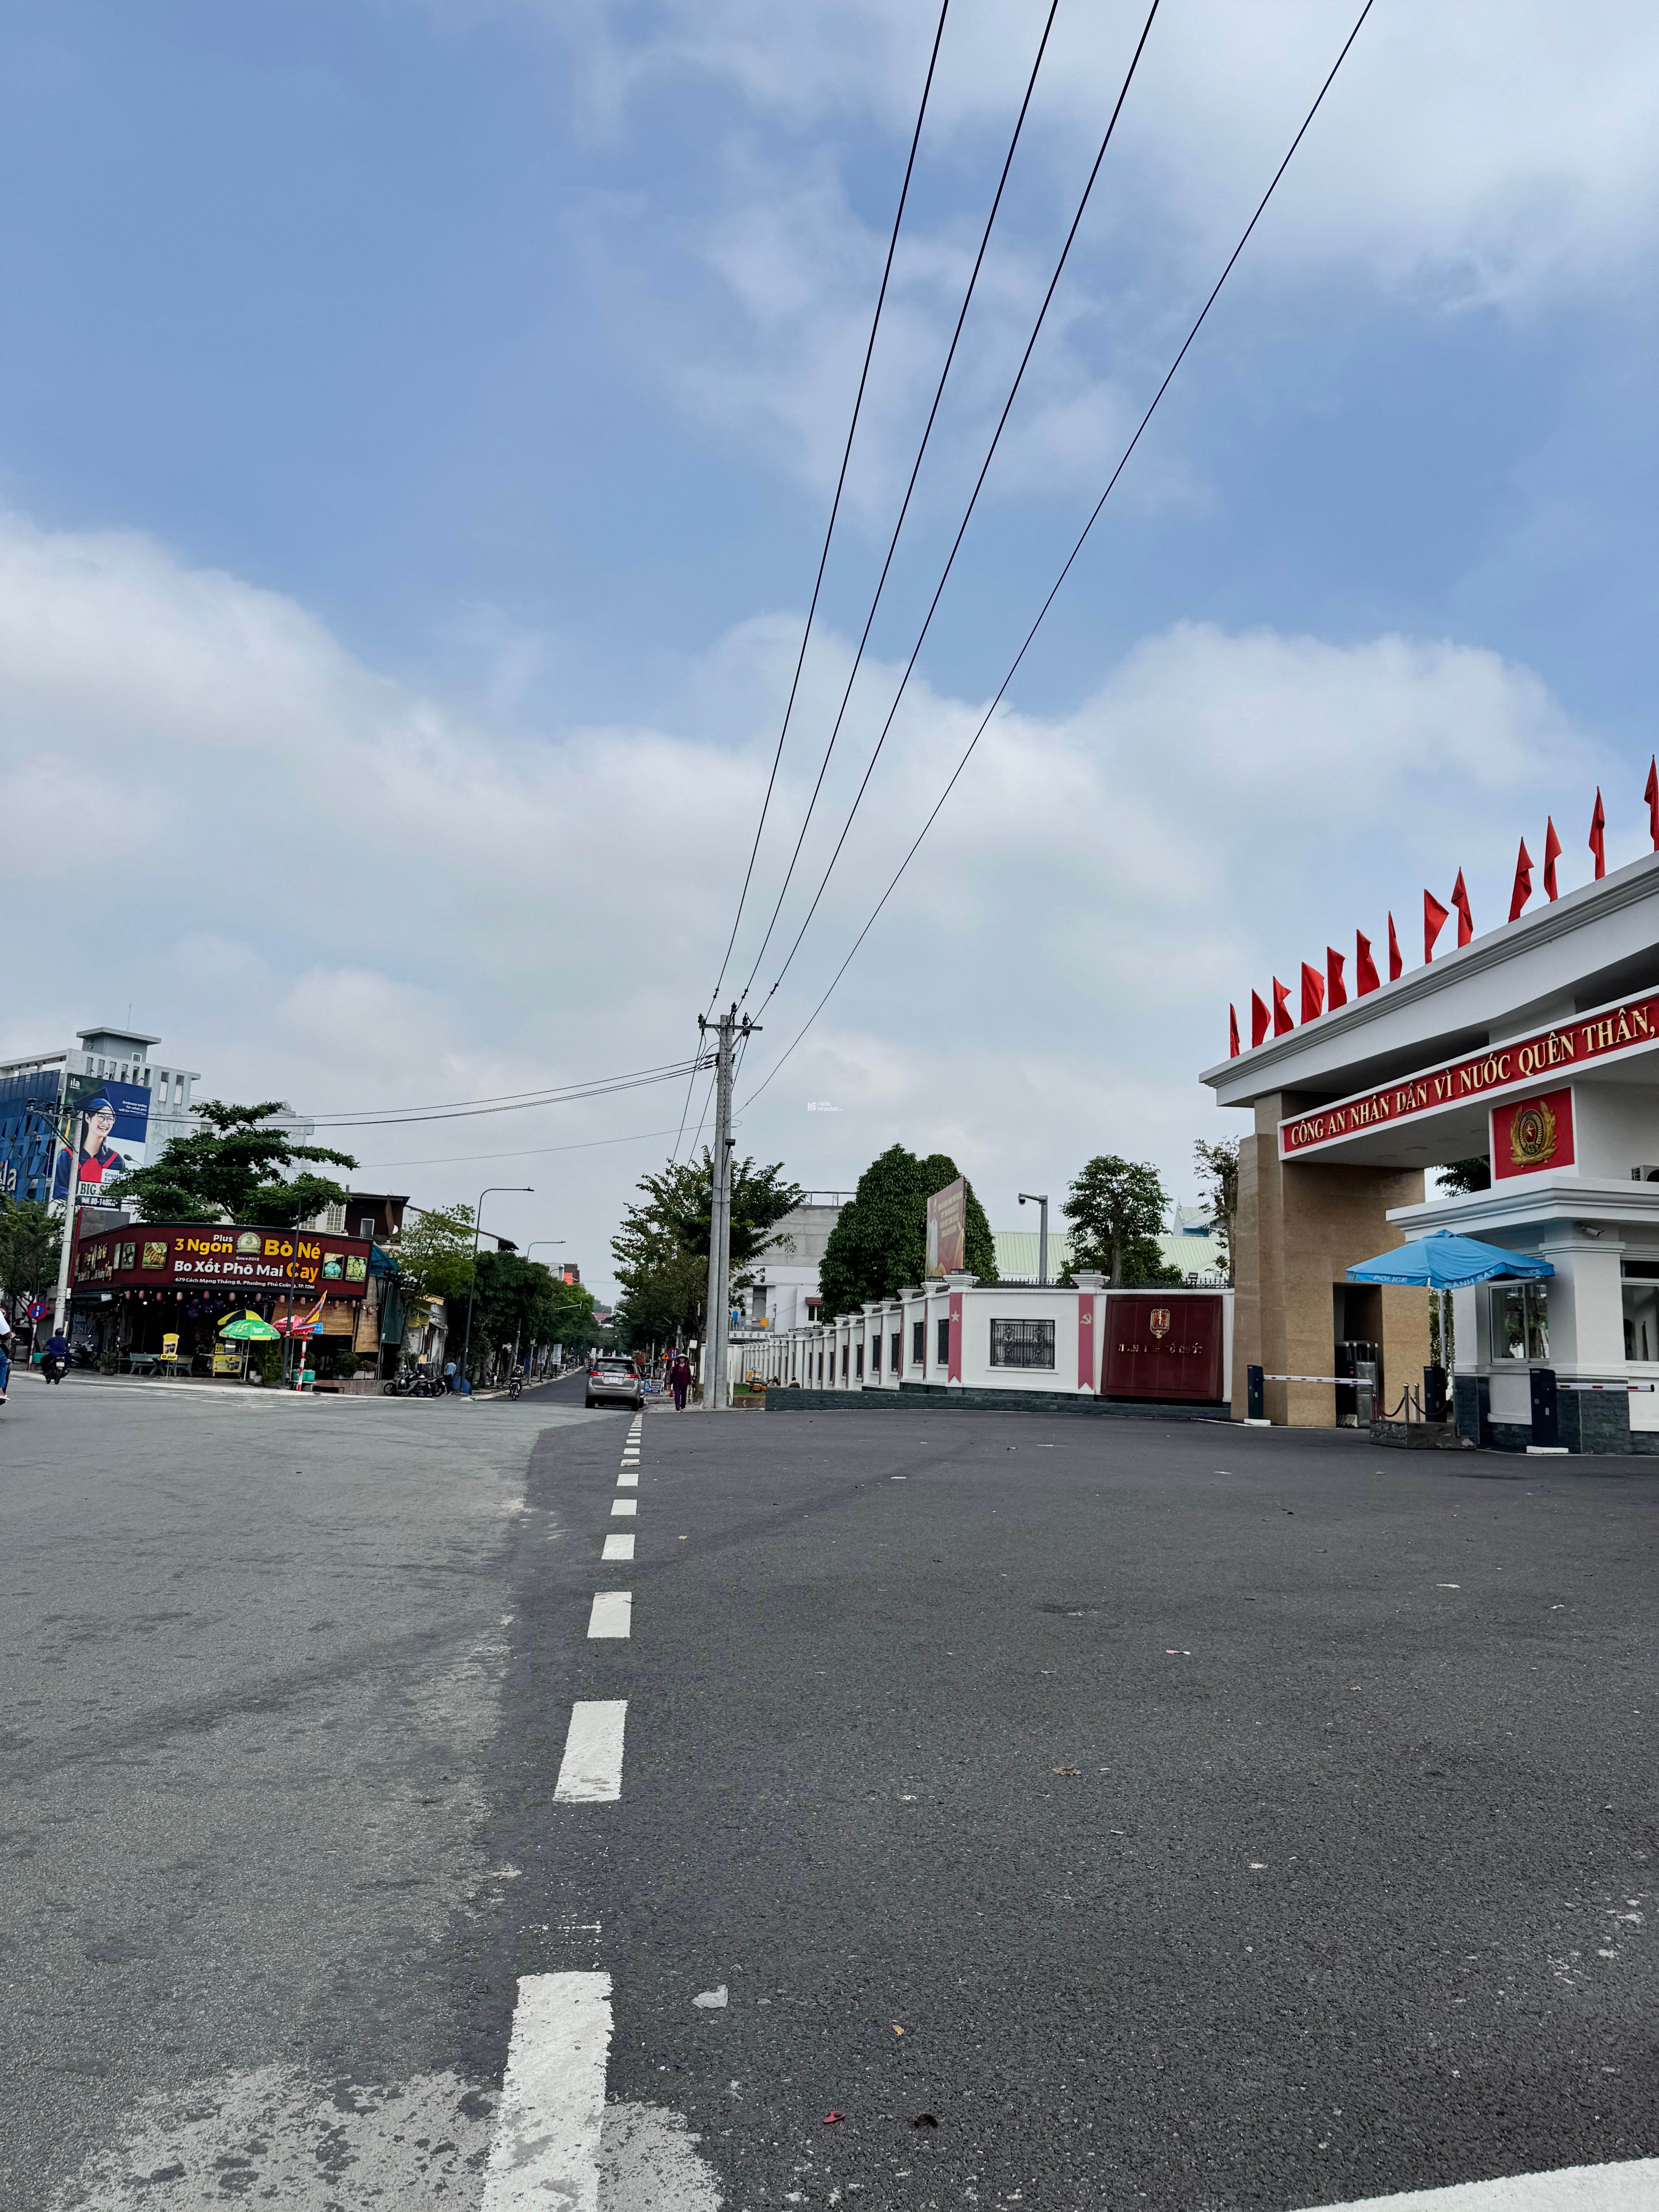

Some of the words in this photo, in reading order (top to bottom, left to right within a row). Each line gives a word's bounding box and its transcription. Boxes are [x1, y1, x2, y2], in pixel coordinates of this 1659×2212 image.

[70, 1078, 80, 1087] ila
[1291, 1119, 1323, 1145] CÔNG
[1328, 1111, 1345, 1135] AN
[1351, 1095, 1389, 1127] NHÂN
[1396, 1082, 1427, 1113] DÂN
[1434, 1070, 1454, 1100] VÌ
[1459, 1053, 1510, 1093] NƯỚC
[1519, 1031, 1574, 1077] QUÊN
[1582, 1006, 1655, 1052] THÂN,
[80, 1183, 96, 1195] BIG
[174, 1238, 184, 1251] 3
[187, 1239, 233, 1255] Ngon
[264, 1239, 293, 1257] Bò
[297, 1242, 321, 1259] Né
[194, 1258, 221, 1273] Xốt
[223, 1262, 253, 1275] Phô
[256, 1264, 283, 1277] Mai
[287, 1262, 319, 1283] Cay
[1373, 1275, 1408, 1283] POLICE
